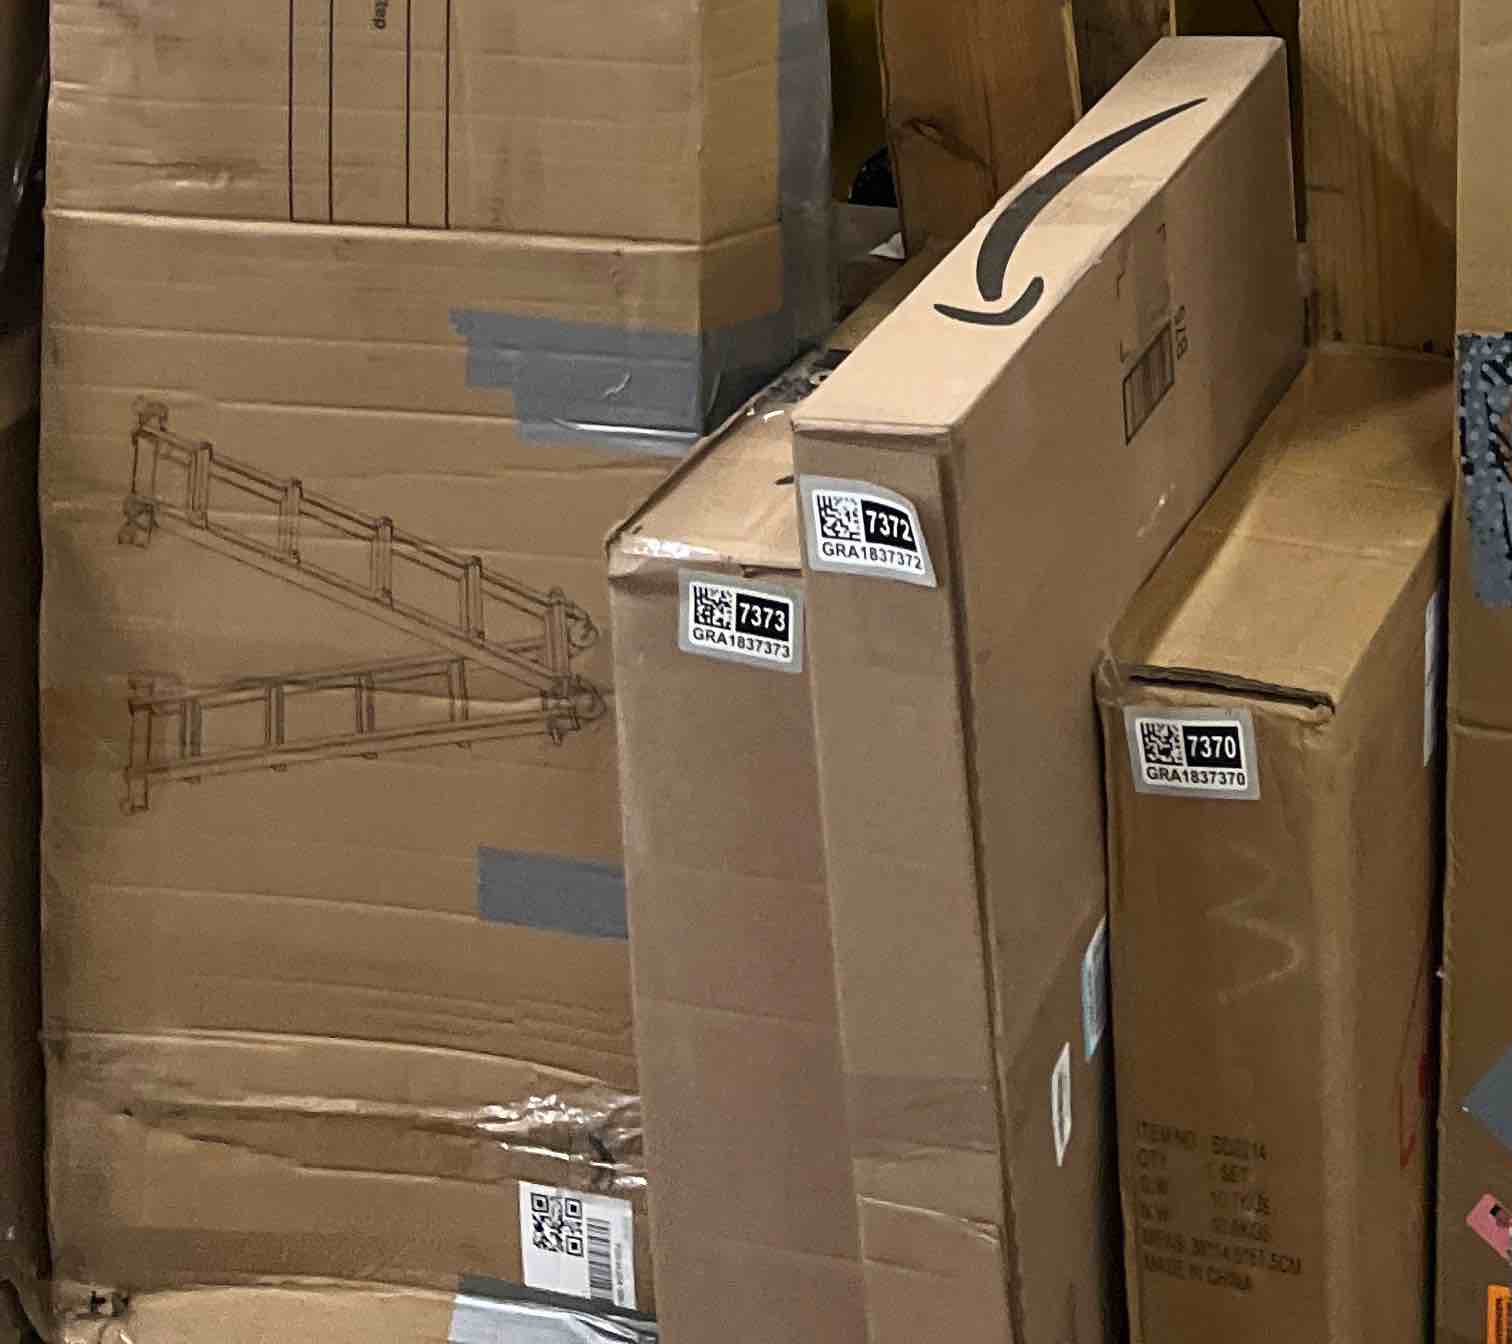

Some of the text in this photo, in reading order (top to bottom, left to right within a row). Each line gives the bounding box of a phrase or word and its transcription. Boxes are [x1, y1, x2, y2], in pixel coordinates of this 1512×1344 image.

[865, 510, 914, 542] 7372
[821, 541, 923, 571] GRA1837372
[738, 602, 787, 632] 7373
[692, 627, 791, 659] GRA1837373
[1186, 735, 1237, 759] 7370
[1146, 766, 1247, 786] GRA1837370
